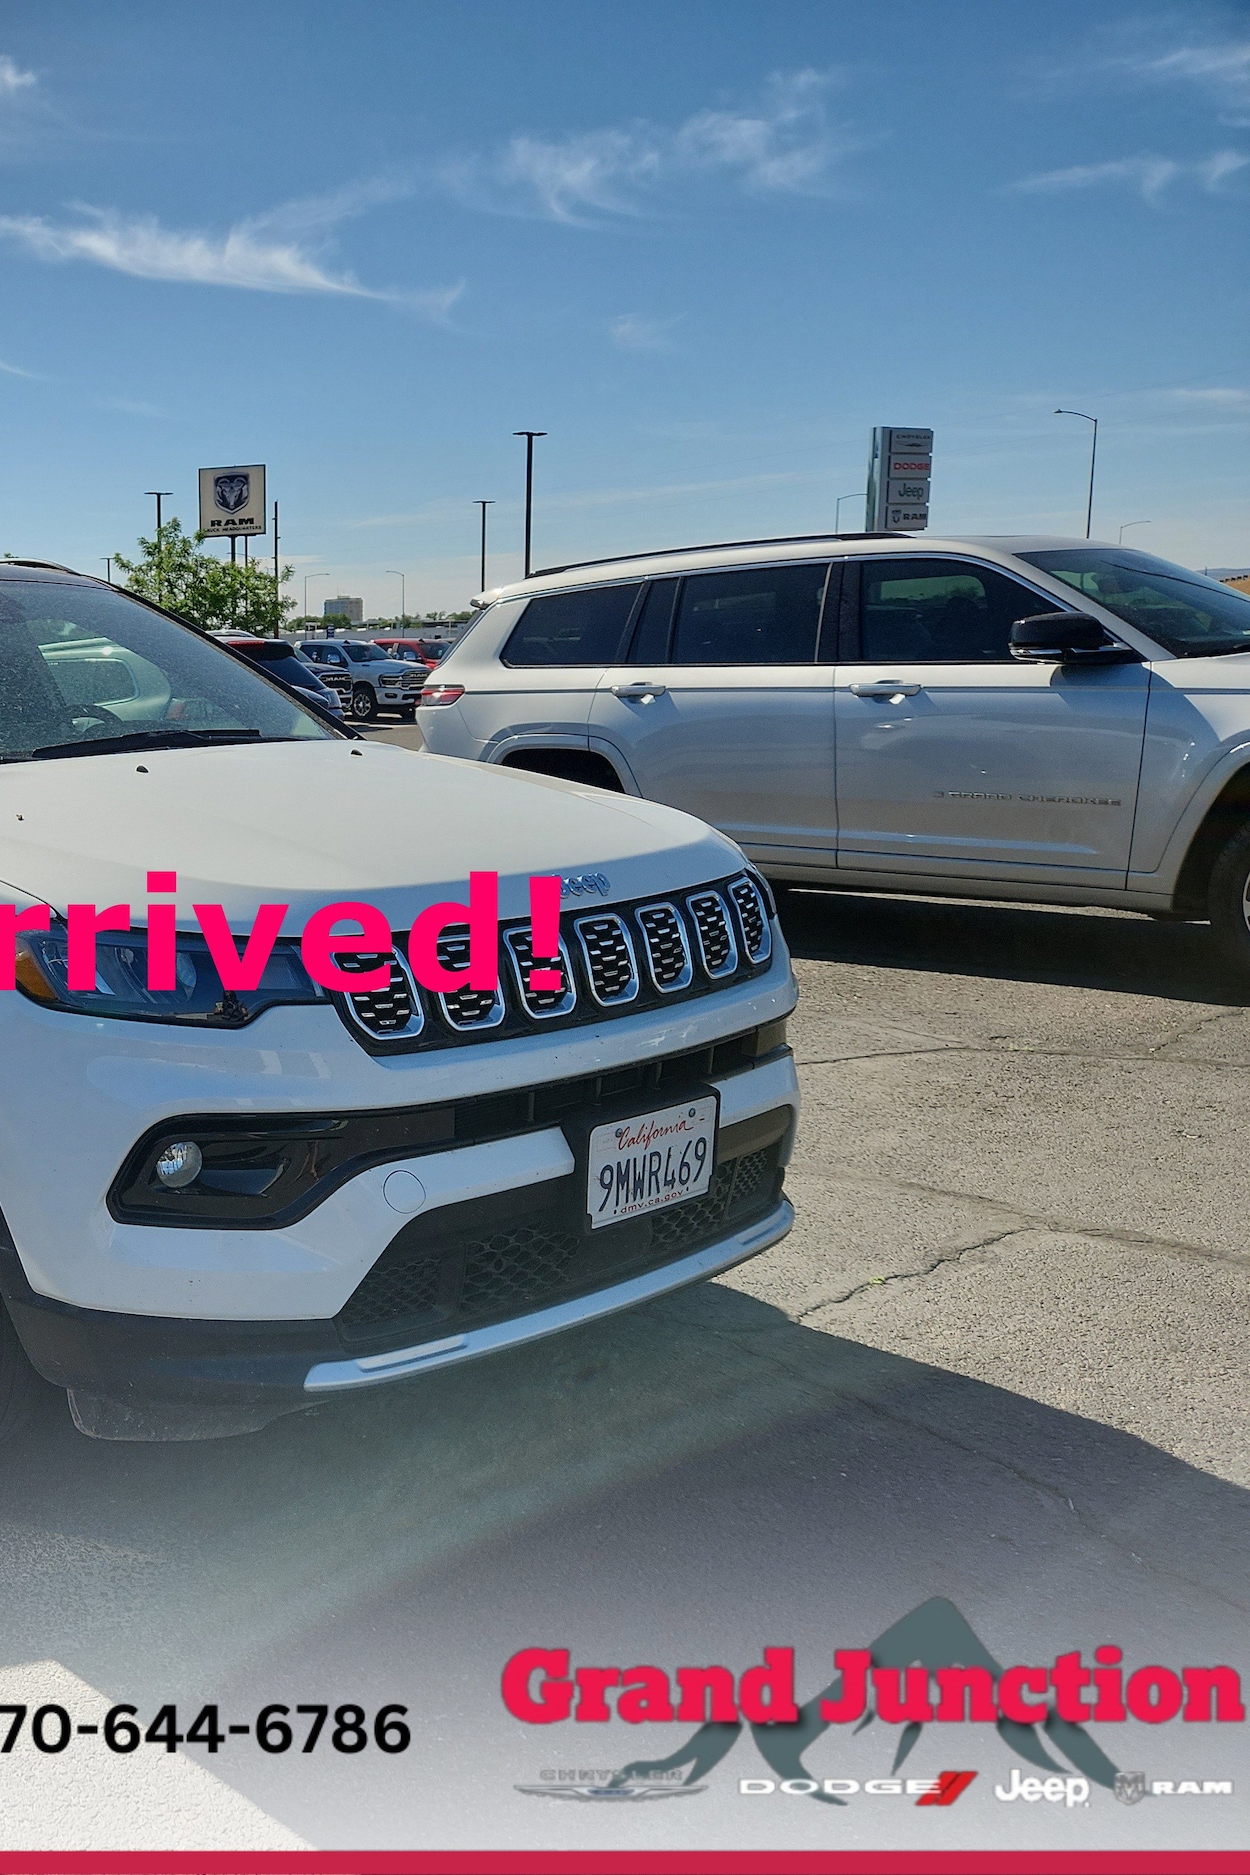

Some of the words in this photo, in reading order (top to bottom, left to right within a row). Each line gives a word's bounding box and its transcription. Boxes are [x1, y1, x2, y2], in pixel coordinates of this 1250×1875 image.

[893, 462, 930, 471] DODGE
[898, 482, 924, 500] Jeep
[210, 517, 255, 527] RAM
[903, 513, 927, 521] RAM
[948, 790, 1012, 801] GRAND
[1018, 793, 1122, 807] CHEROKEE
[618, 1119, 694, 1151] California
[598, 1137, 707, 1212] 9MWR469
[620, 1189, 685, 1215] dmv.ca.gov
